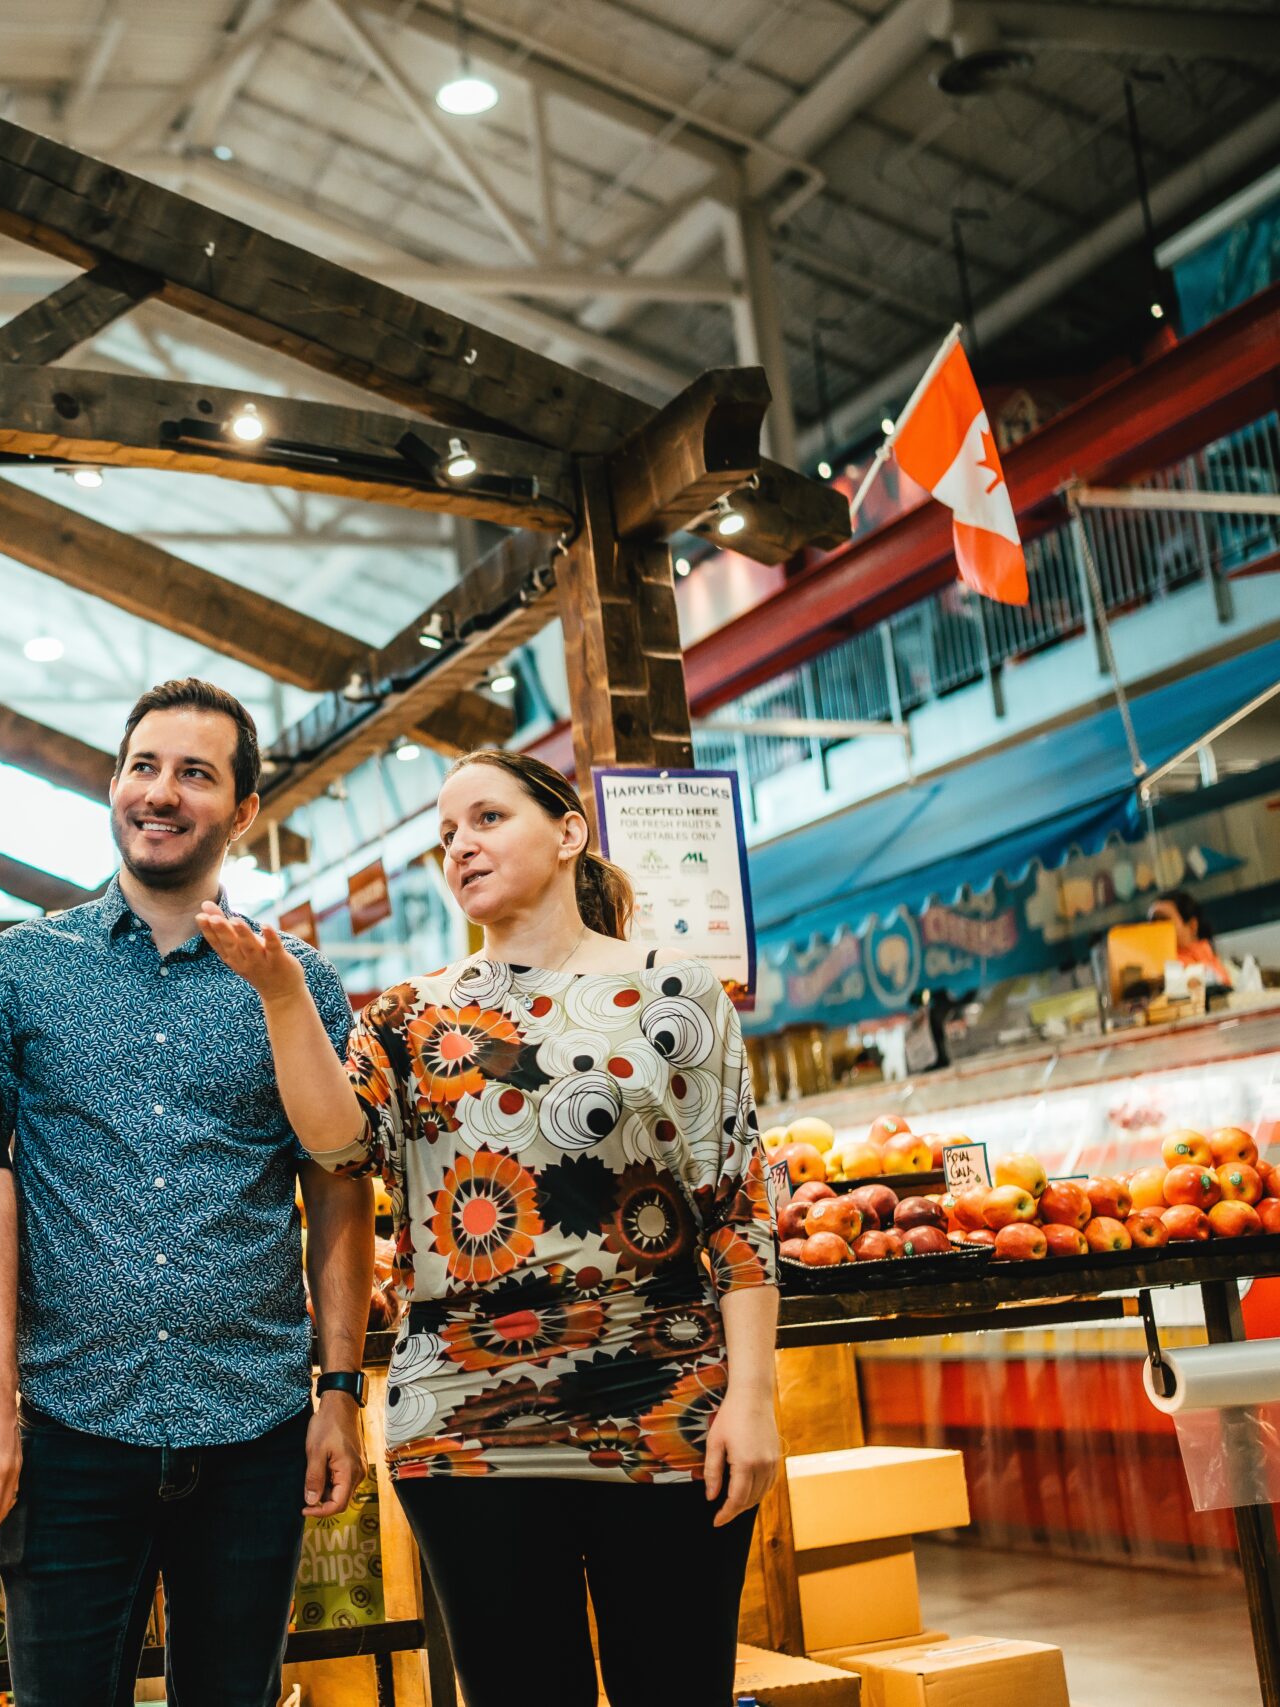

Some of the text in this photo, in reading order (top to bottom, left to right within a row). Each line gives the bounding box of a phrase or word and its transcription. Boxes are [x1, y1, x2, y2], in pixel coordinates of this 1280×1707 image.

[606, 782, 730, 801] HARVEST BUCKS
[620, 806, 719, 816] ACCEPTED HERE
[620, 819, 639, 828] FOR
[642, 819, 674, 828] FRESH
[676, 818, 712, 828] FRUITS
[627, 831, 718, 841] VEGETABLES ONLY
[681, 851, 708, 863] ML
[298, 1552, 367, 1587] chips
